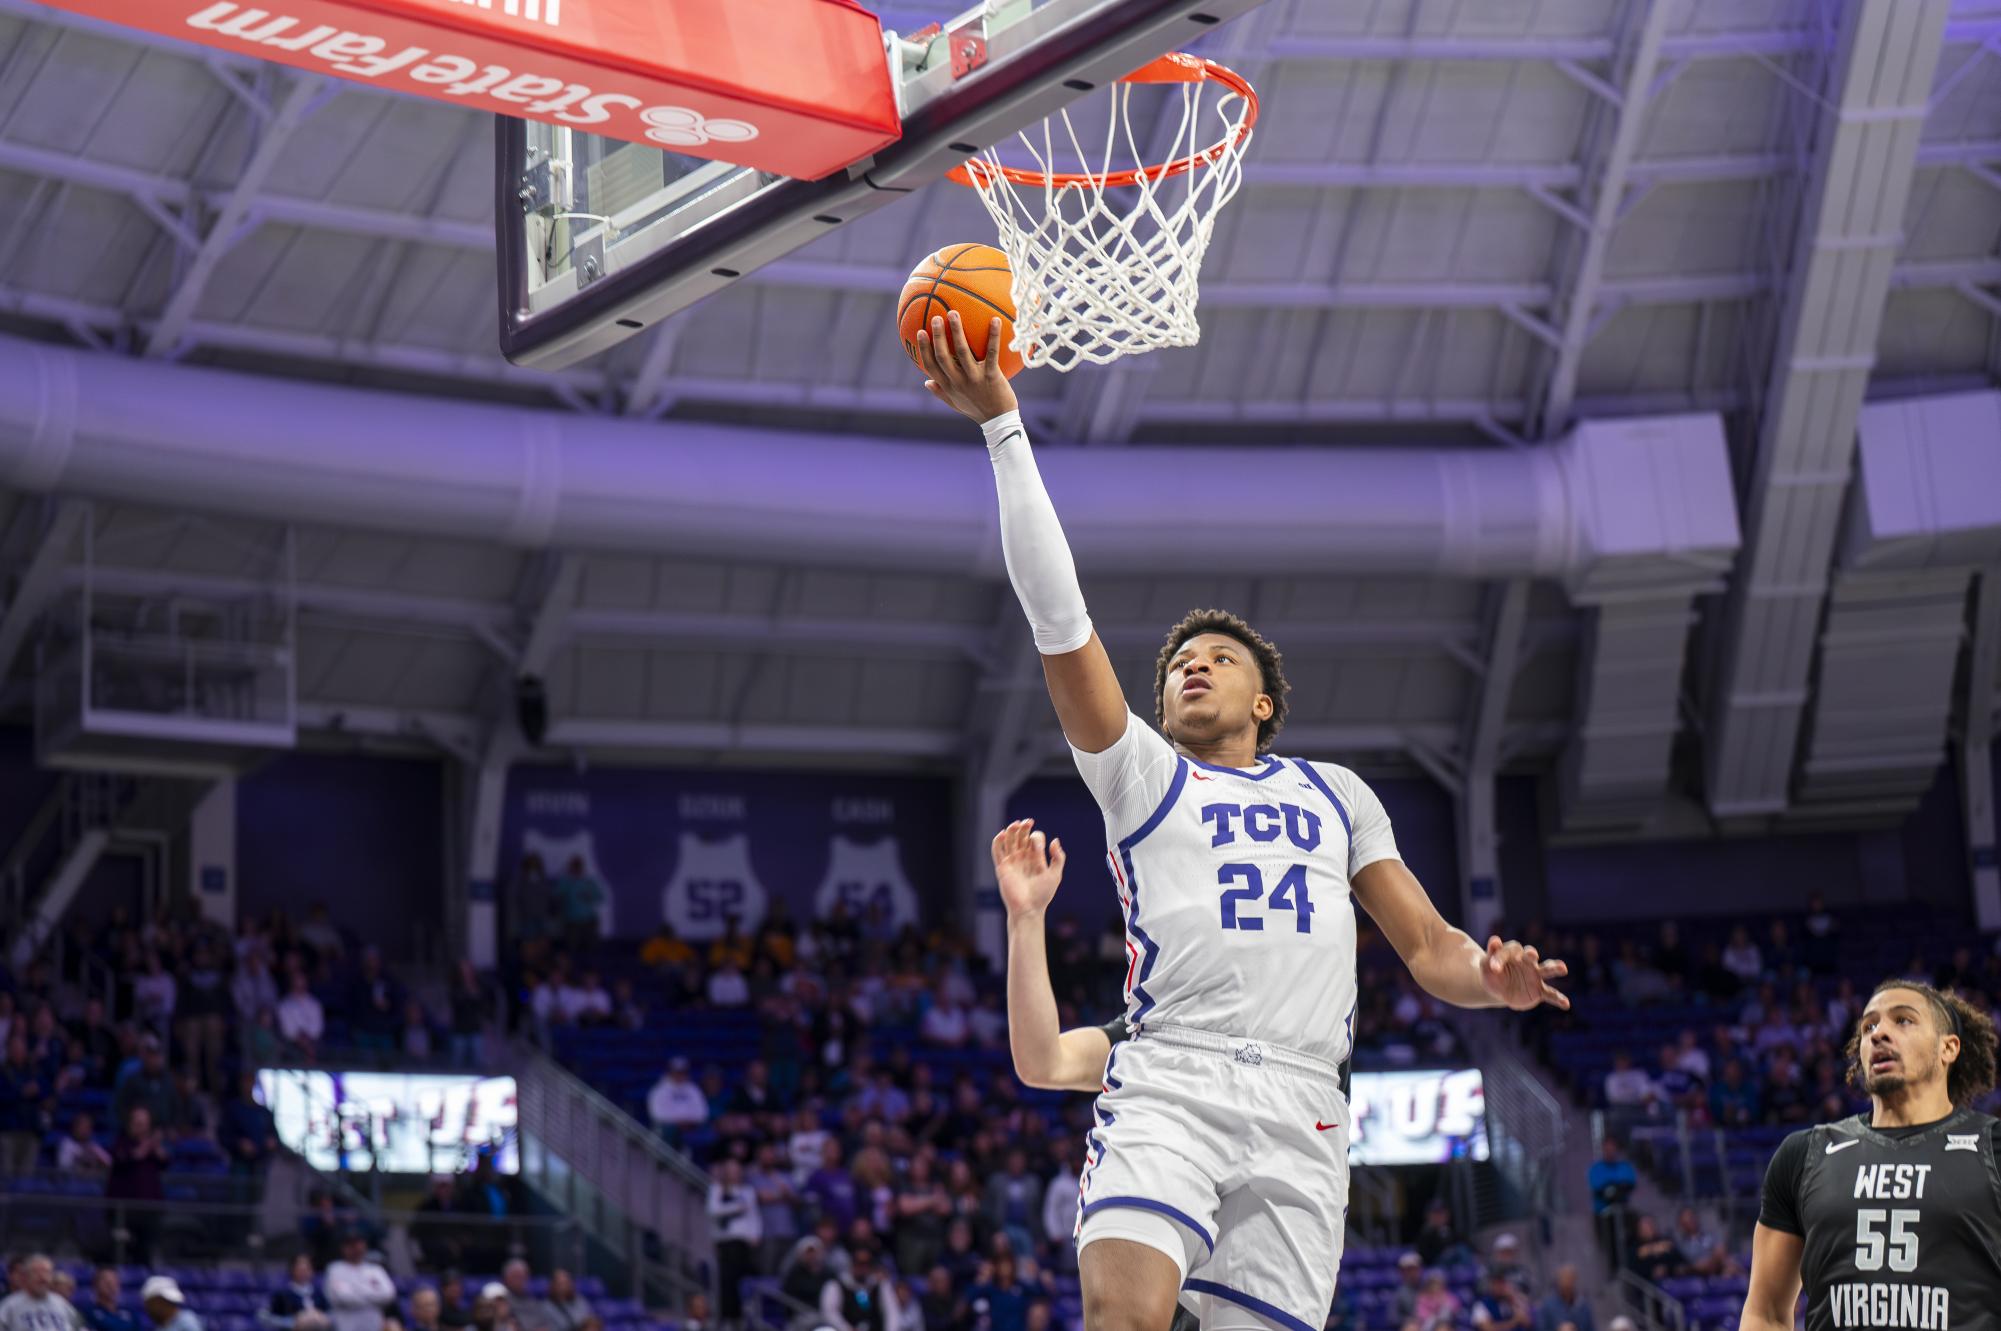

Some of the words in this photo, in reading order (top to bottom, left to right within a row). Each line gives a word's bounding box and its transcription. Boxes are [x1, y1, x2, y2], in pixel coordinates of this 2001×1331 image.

[1201, 802, 1322, 853] TCU
[1217, 863, 1315, 934] 24
[1853, 1163, 1932, 1200] WEST
[1855, 1208, 1921, 1273] 55
[1830, 1283, 1950, 1331] VIRGINIA
